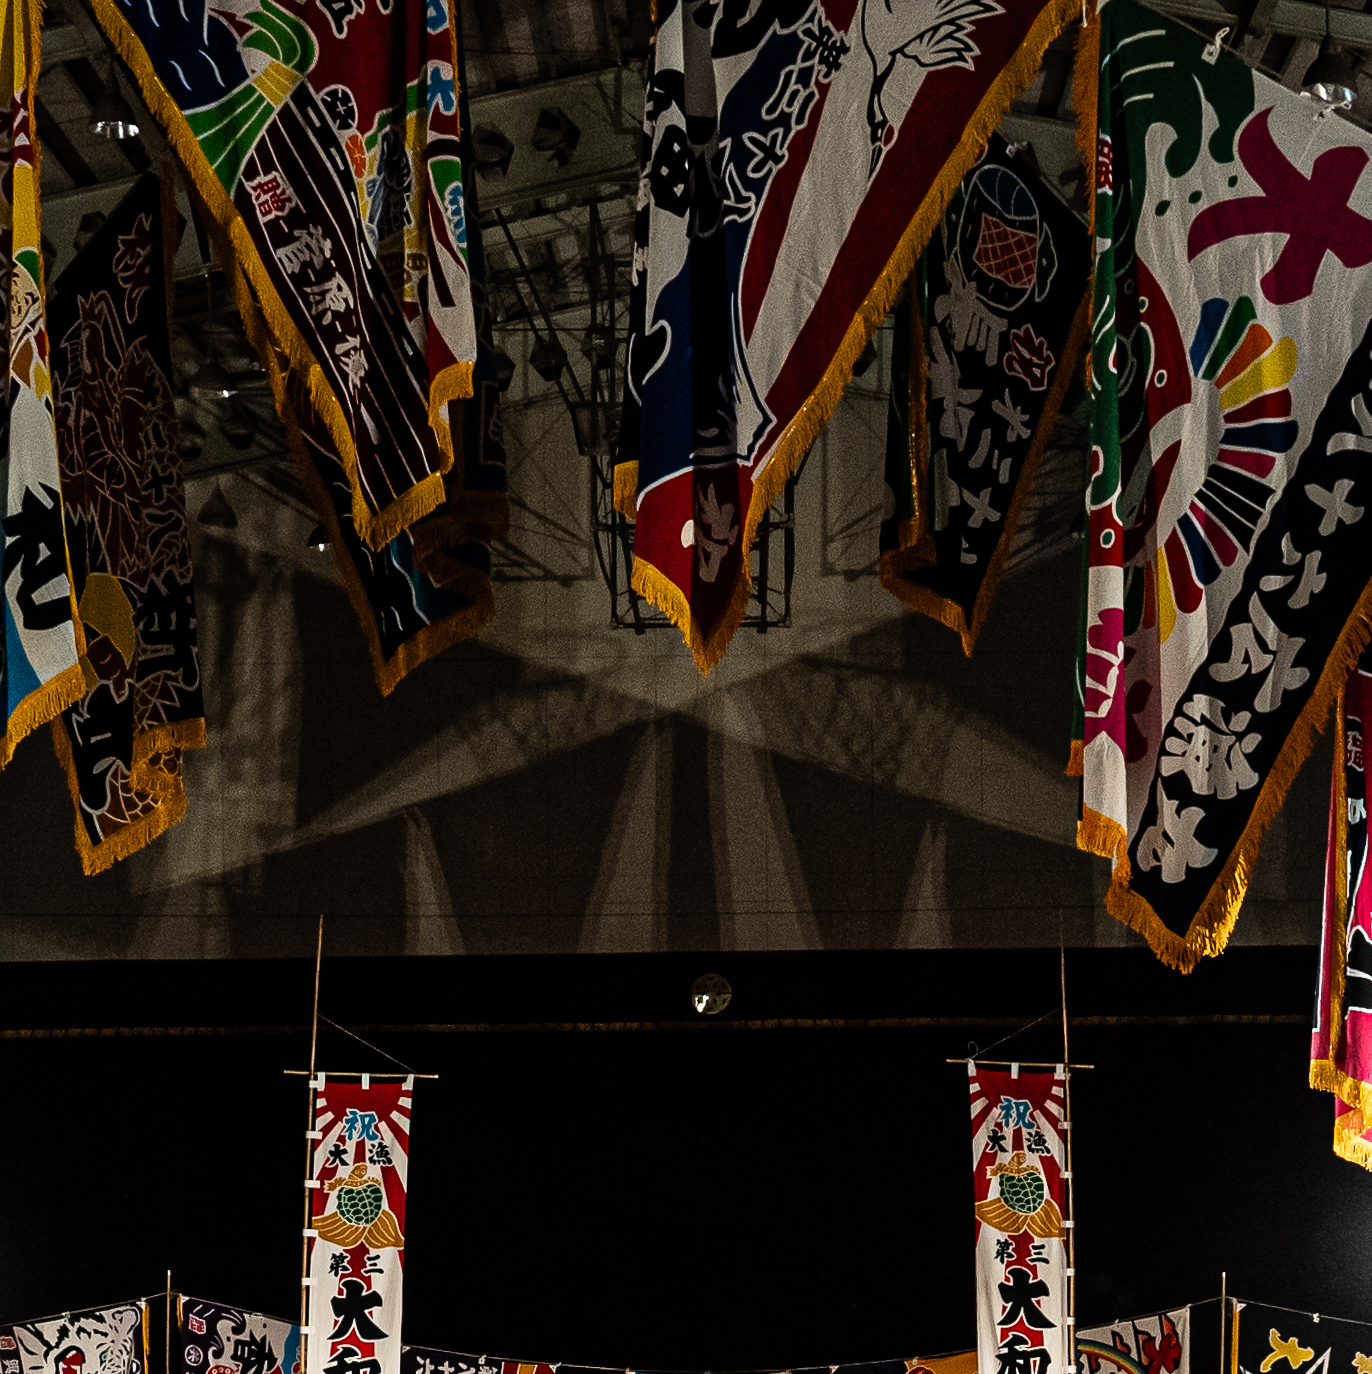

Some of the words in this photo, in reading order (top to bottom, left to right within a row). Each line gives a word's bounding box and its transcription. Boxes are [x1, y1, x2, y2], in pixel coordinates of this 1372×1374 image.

[246, 170, 299, 223] 贈
[1003, 321, 1056, 393] 祝
[344, 1109, 379, 1141] 祝
[999, 1096, 1036, 1130] 祝
[327, 1142, 394, 1168] 大漁
[987, 1130, 1053, 1156] 大漁
[328, 1252, 385, 1279] 第三
[993, 1238, 1051, 1265] 第三
